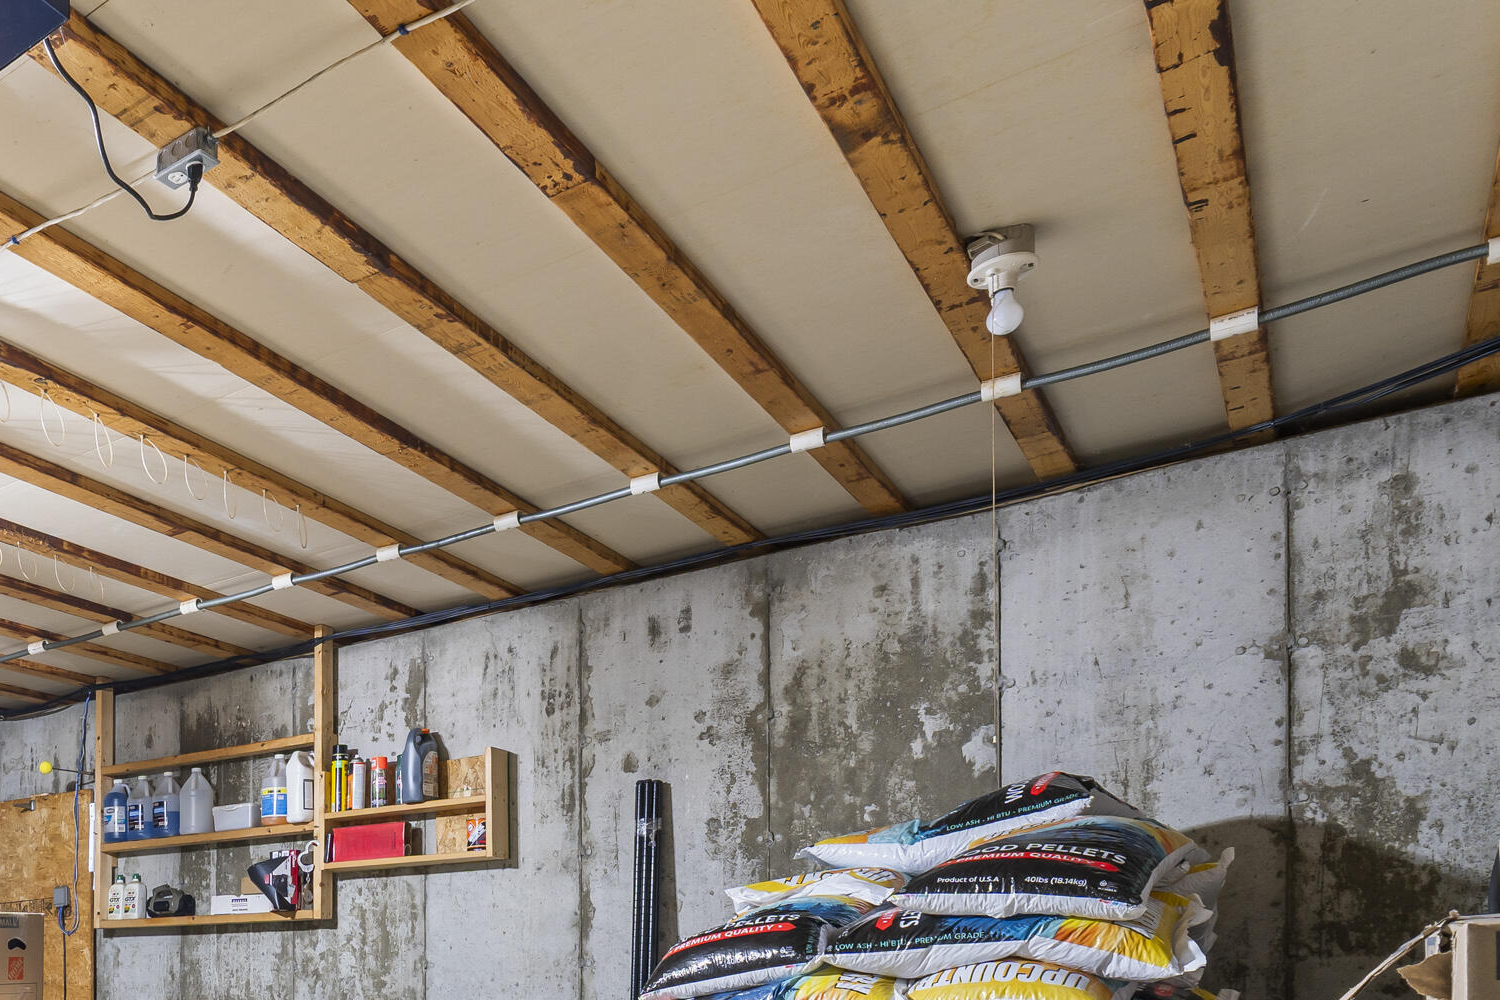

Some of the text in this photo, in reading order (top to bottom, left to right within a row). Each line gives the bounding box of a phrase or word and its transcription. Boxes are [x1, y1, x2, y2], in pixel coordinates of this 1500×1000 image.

[946, 793, 1080, 832] LOW ASH HI BTU PREMIUM GRADE
[956, 852, 1095, 864] PREMIUM QUALITY
[1026, 843, 1127, 865] PELLETS
[1025, 876, 1087, 887] 40lbs (18.14kg)
[673, 924, 769, 953] PREMIUM QUALITY
[835, 931, 985, 952] LOW ASH GRADE
